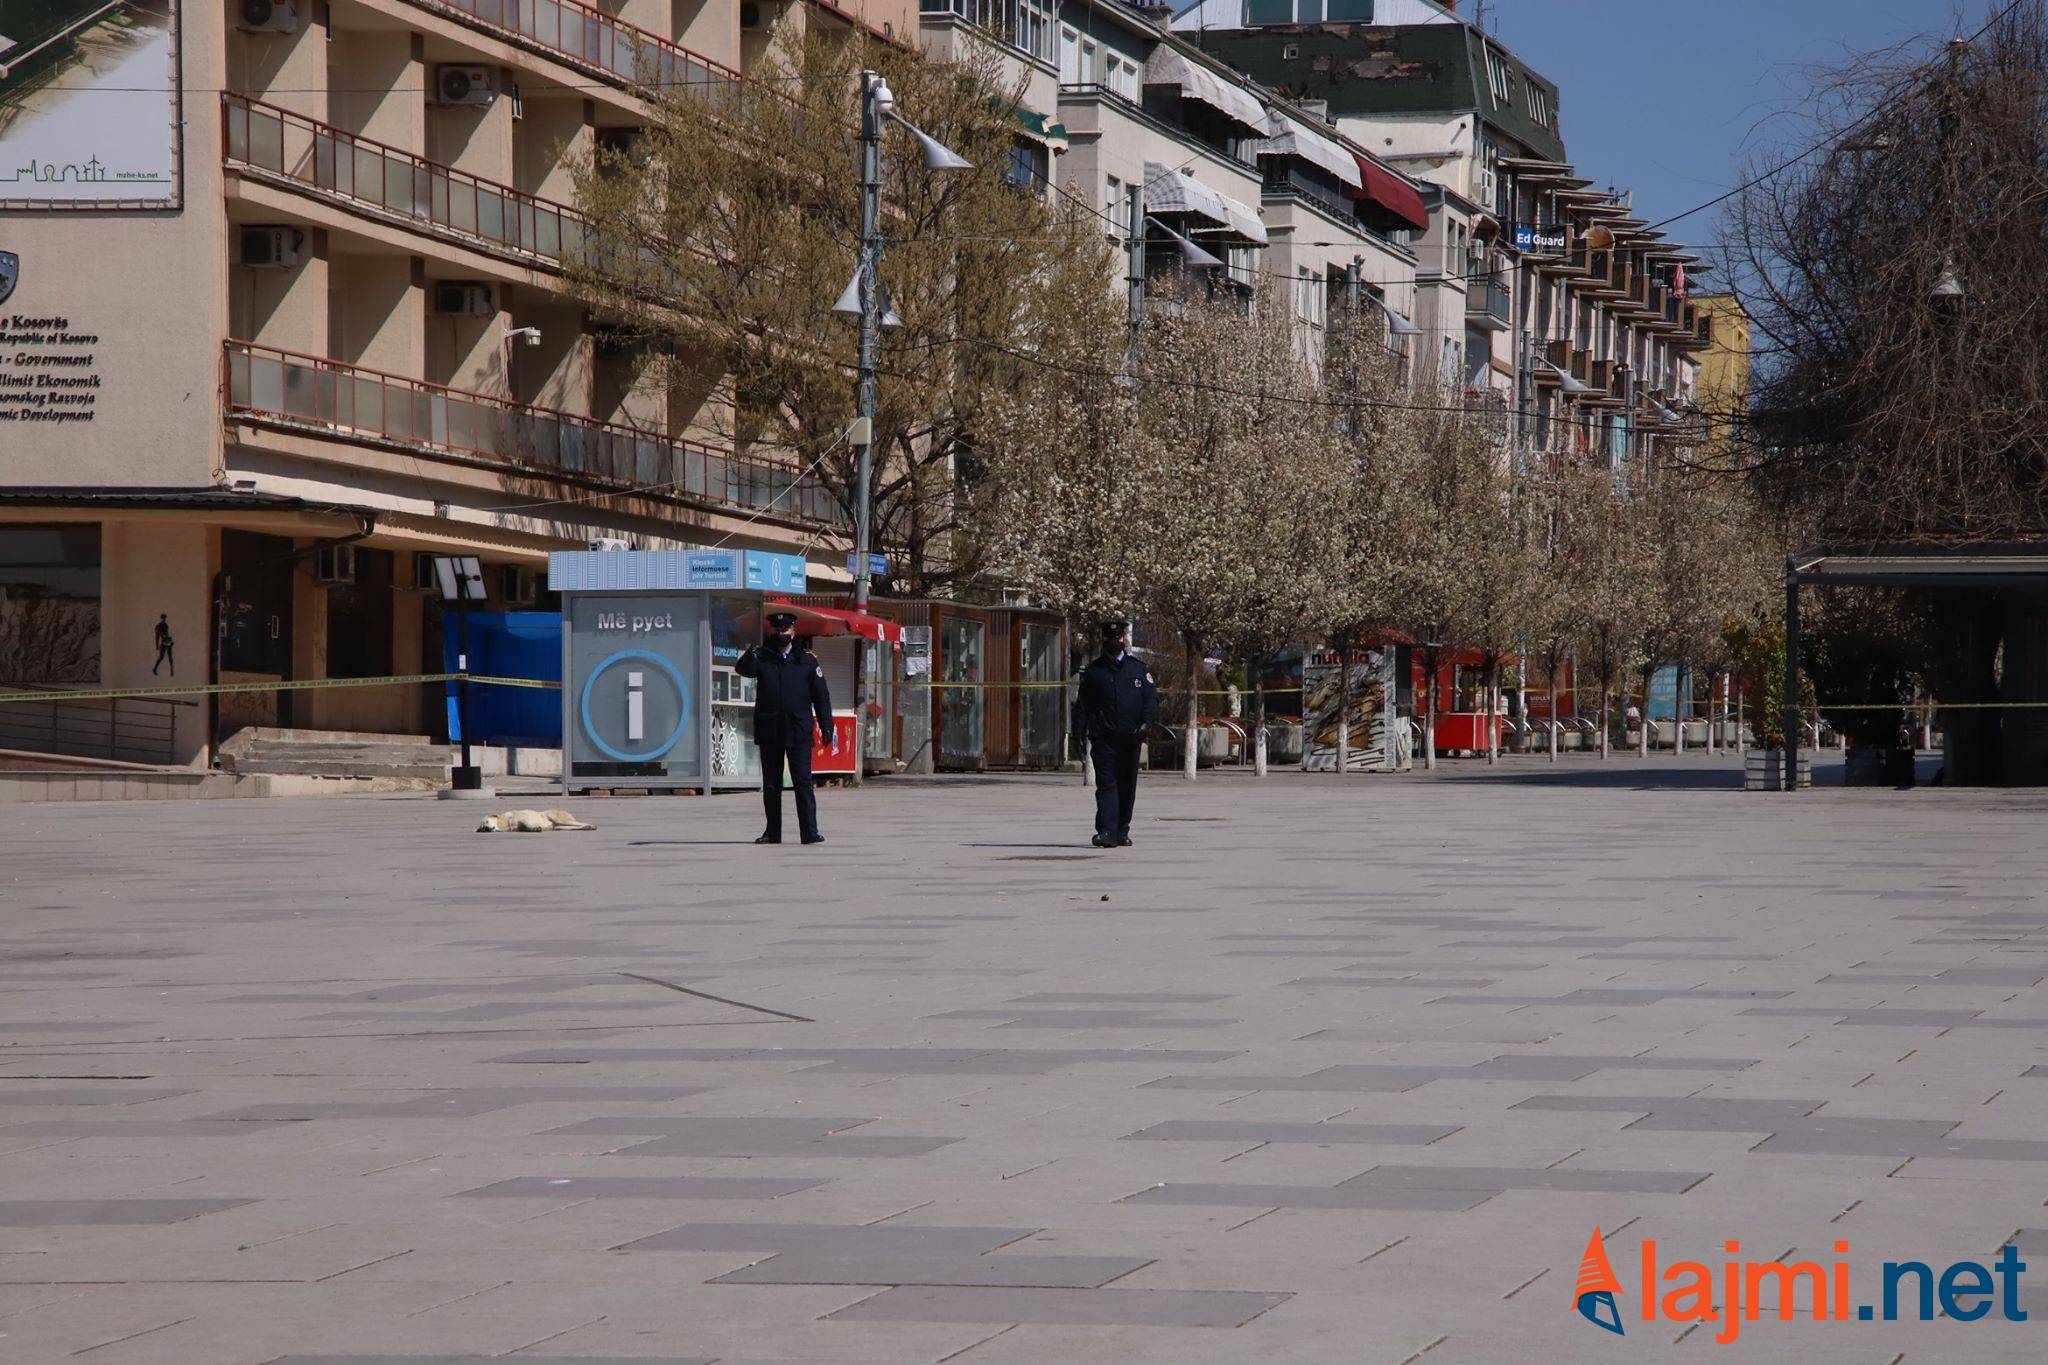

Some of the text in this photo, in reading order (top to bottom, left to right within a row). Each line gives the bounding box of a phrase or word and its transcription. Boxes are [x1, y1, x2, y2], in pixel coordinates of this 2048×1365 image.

[1517, 233, 1565, 247] Ed Guard
[11, 315, 68, 329] Kosovës
[0, 332, 98, 345] Republic of Kosovo
[15, 351, 94, 366] Government
[36, 374, 101, 387] Ekonomik
[47, 391, 95, 407] Razvoja
[20, 408, 95, 423] Development
[692, 565, 729, 573] Informuese
[598, 612, 673, 632] Më pyet
